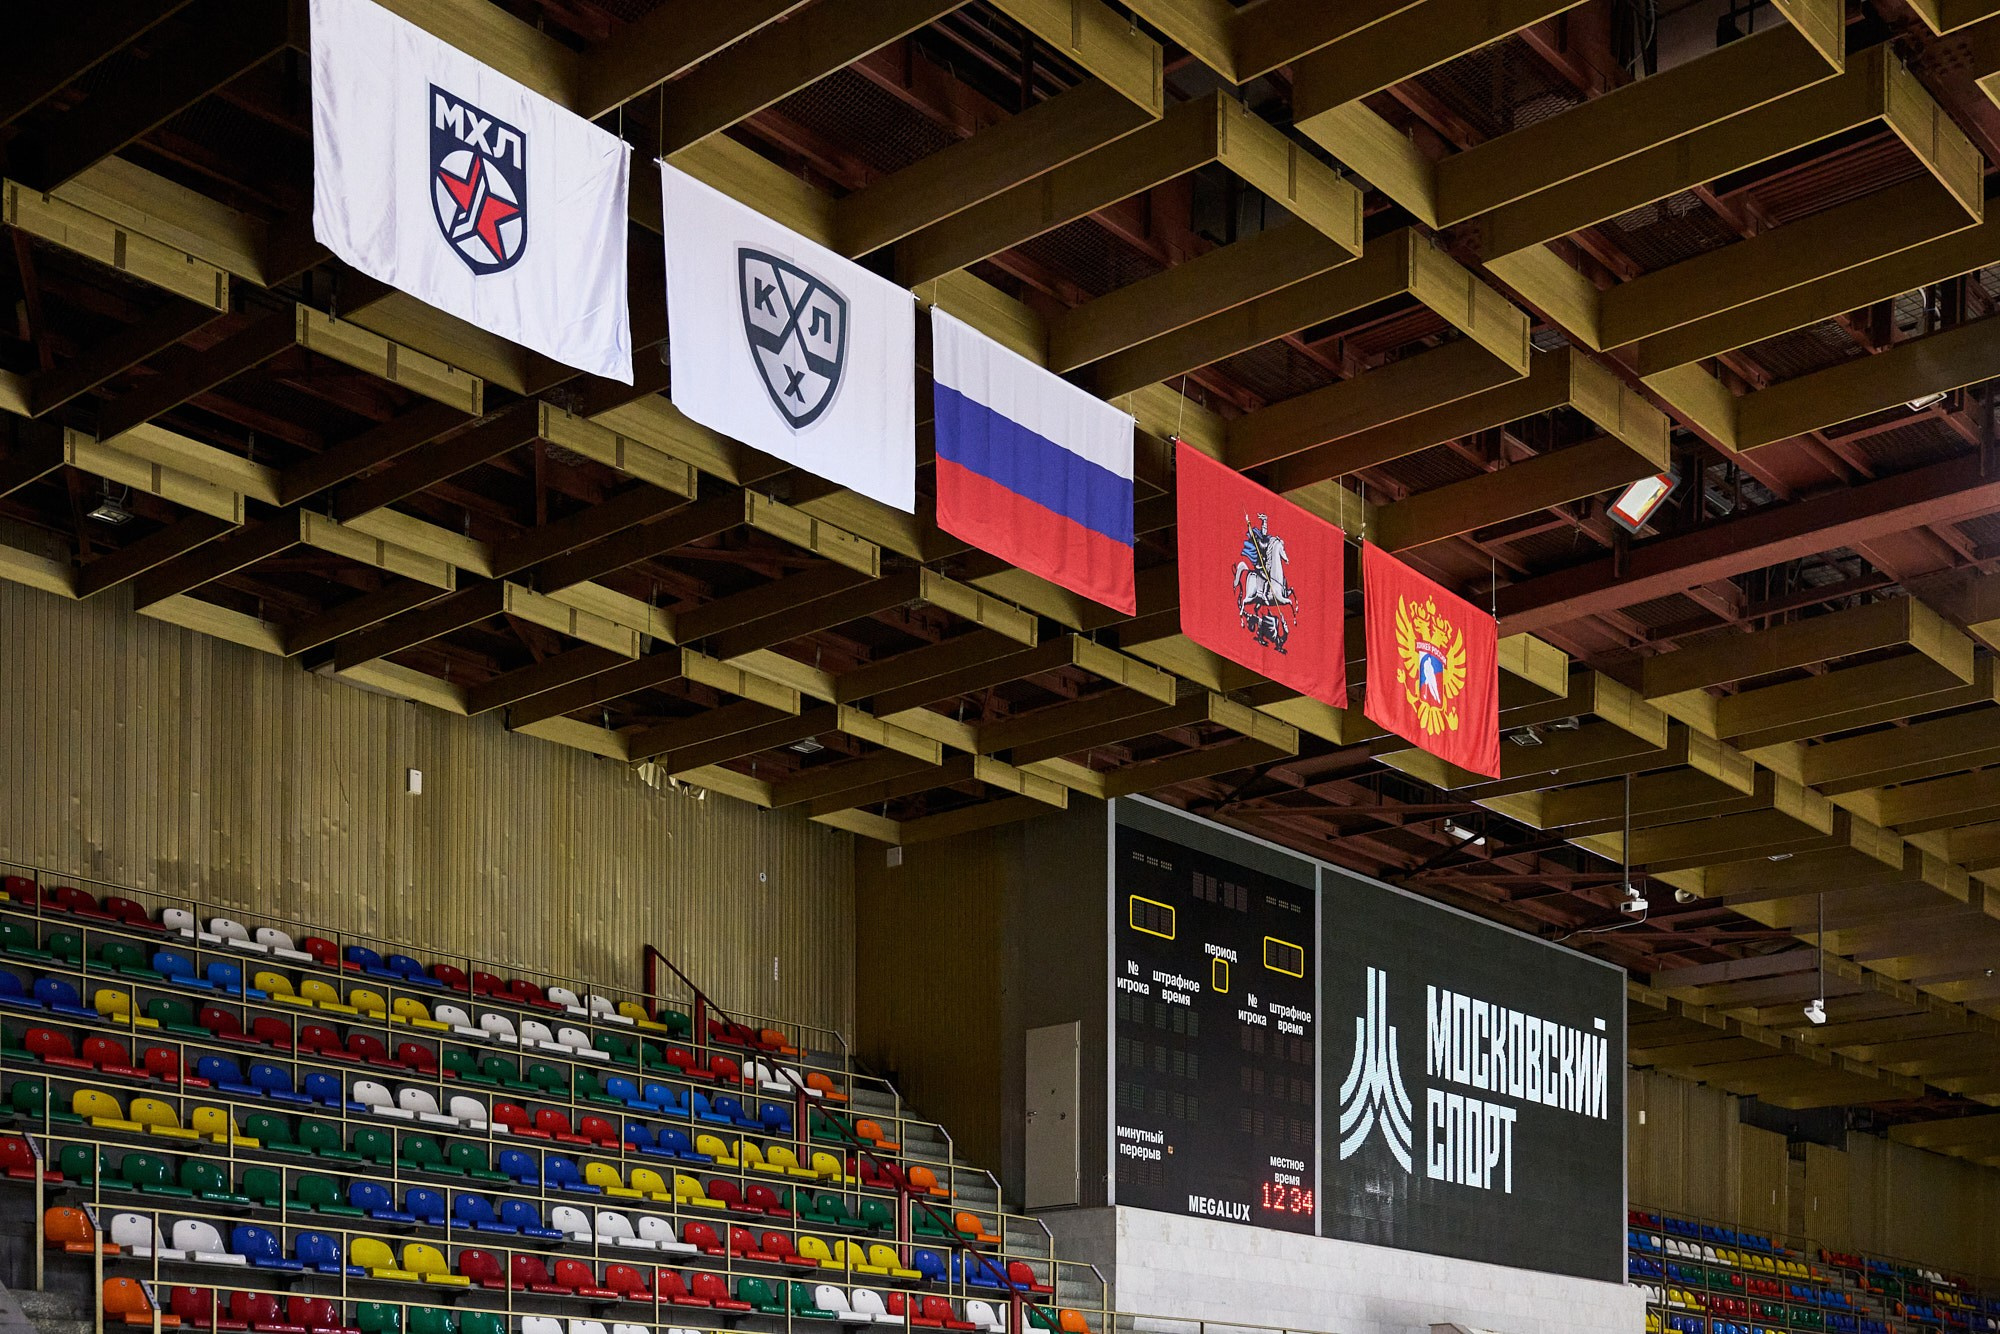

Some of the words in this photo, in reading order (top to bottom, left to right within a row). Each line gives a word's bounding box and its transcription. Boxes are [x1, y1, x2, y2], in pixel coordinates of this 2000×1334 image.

[435, 93, 521, 170] МХЛ
[754, 277, 778, 319] К
[808, 306, 833, 345] Л
[784, 364, 806, 404] Х
[1205, 942, 1238, 964] период
[1127, 959, 1139, 976] №
[1117, 976, 1150, 995] игрока
[1153, 969, 1200, 993] штрафное
[1162, 989, 1191, 1006] время
[1247, 992, 1258, 1009] №
[1238, 1009, 1267, 1026] игрока
[1269, 1001, 1312, 1023] штрафное
[1277, 1019, 1304, 1036] время
[1427, 984, 1608, 1120] МОСКОВСКИЙ
[1117, 1125, 1164, 1145] минутный
[1427, 1087, 1517, 1194] СПОРТ
[1120, 1141, 1161, 1161] перерыв
[1270, 1155, 1305, 1172] местное
[1274, 1172, 1301, 1186] время
[1189, 1194, 1251, 1221] MEGALUX
